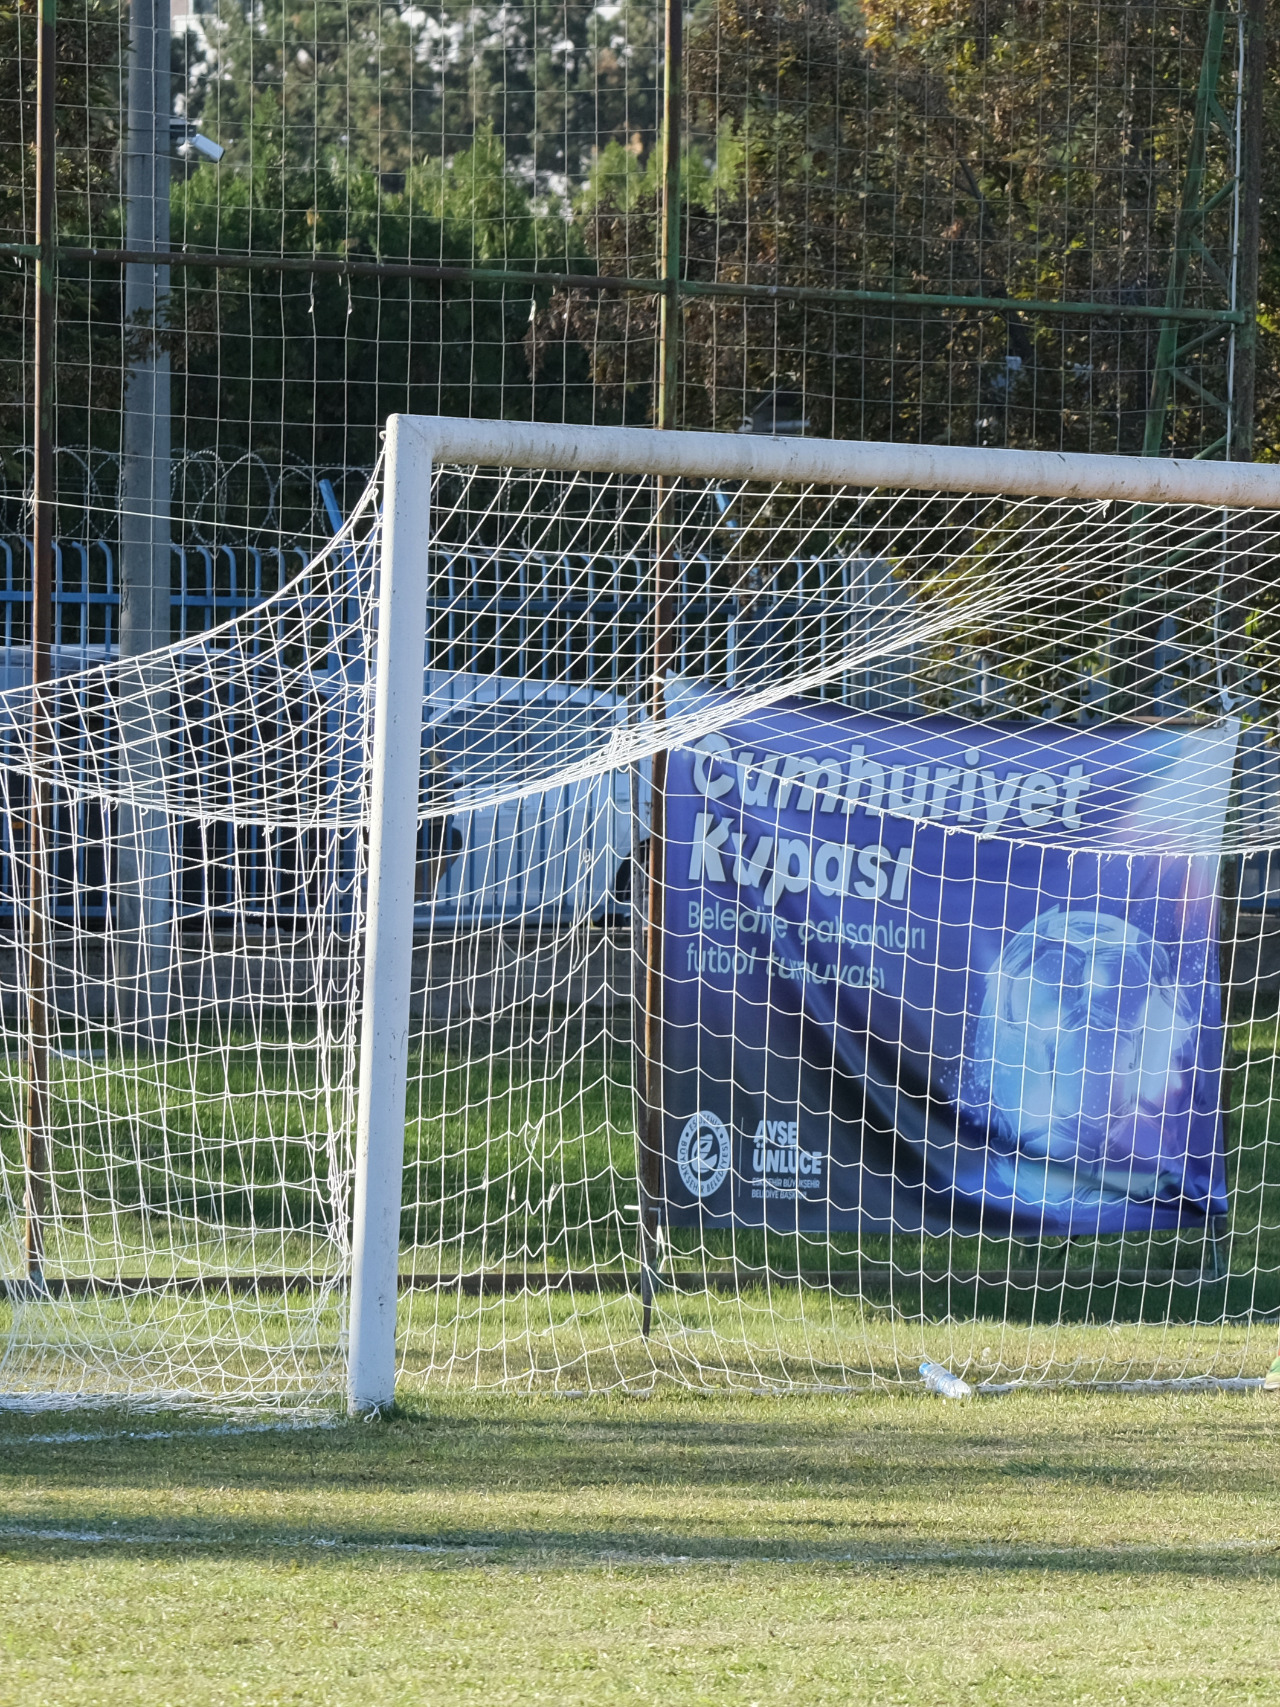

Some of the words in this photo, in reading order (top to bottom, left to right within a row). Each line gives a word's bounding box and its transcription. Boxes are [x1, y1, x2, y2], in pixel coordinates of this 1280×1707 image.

[694, 733, 1091, 840] Cumhuriyet
[688, 812, 912, 906] Kupası
[798, 916, 926, 949] çalışanları
[686, 942, 757, 975] futbol
[753, 1120, 798, 1147] AYŞE
[753, 1143, 822, 1174] ÜNLÜCE
